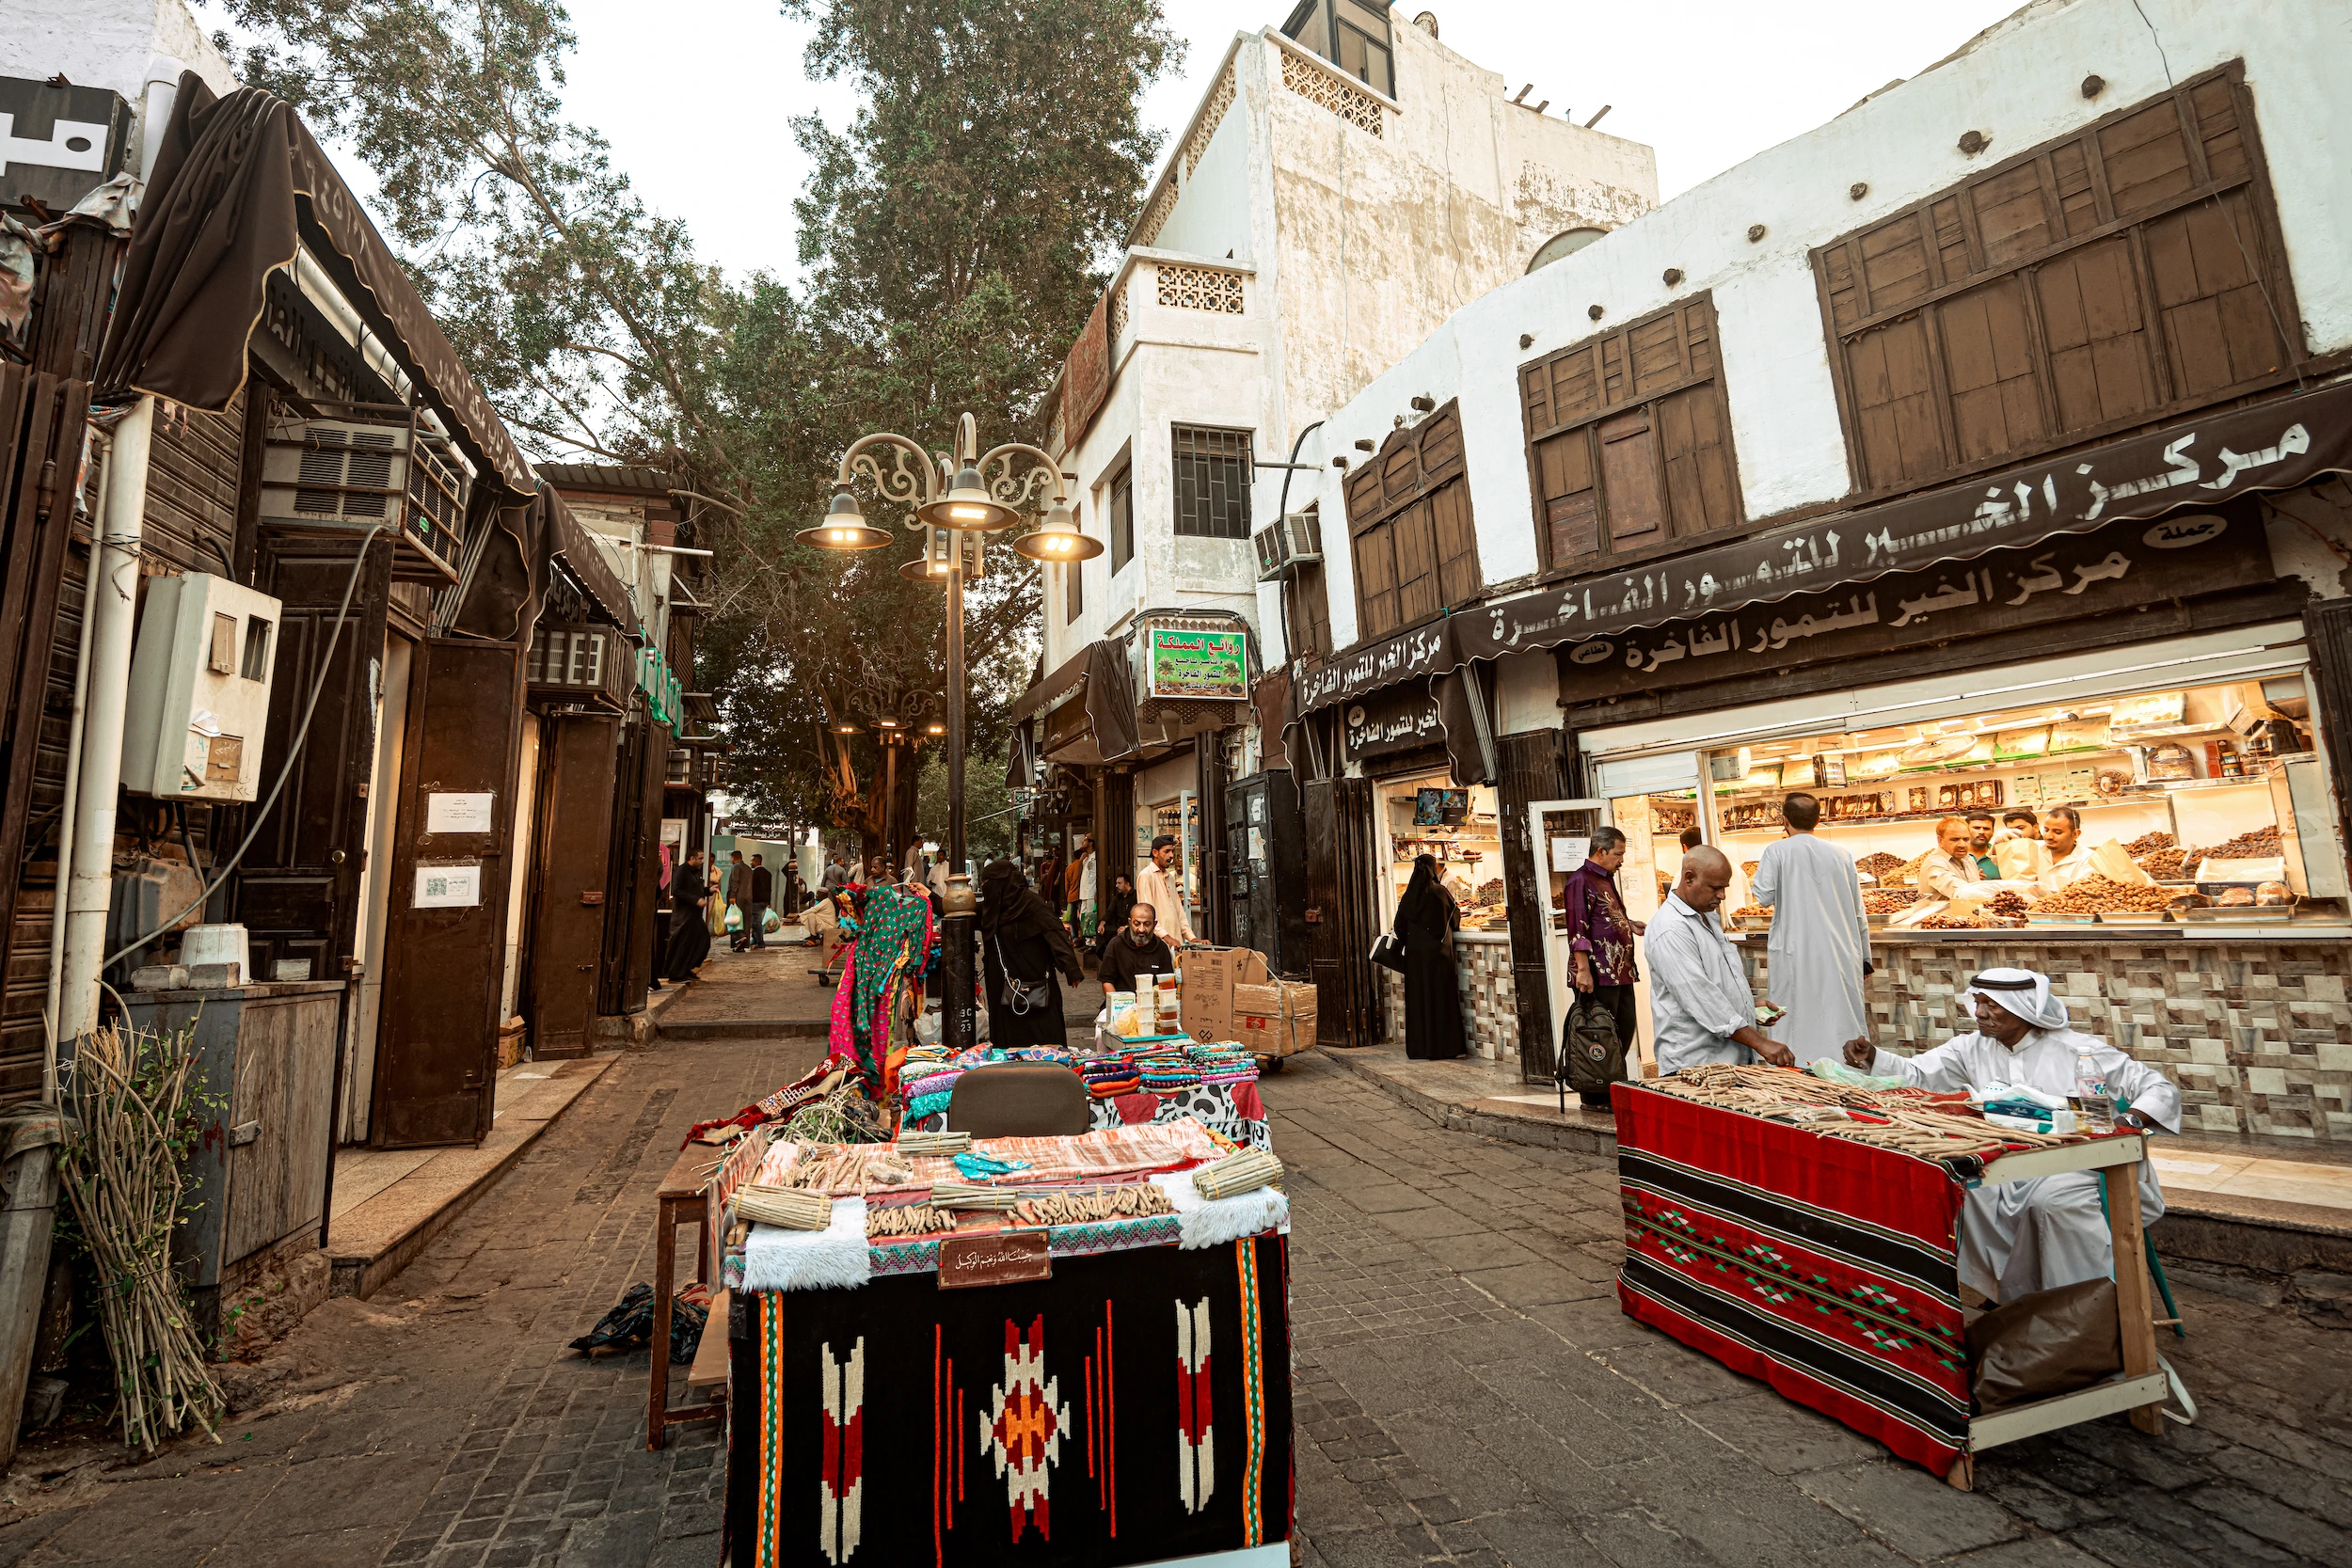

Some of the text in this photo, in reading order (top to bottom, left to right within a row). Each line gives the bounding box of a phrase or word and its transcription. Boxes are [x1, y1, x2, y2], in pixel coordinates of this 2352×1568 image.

[1489, 423, 2311, 646] مركز الخير للتمور الفاخرة
[2158, 522, 2216, 541] جملة
[1624, 550, 2132, 673] مركز الخير للتمور الفاخرة
[1157, 634, 1241, 656] روائع المملكة
[1579, 643, 1608, 661] قطاعي
[1178, 669, 1222, 680] للتمور الفاخرة
[1302, 630, 1441, 706] مركز الخير للتمور الفاخرة
[1348, 707, 1438, 751] لخير للتمور الفاخرة
[960, 1022, 972, 1033] 23
